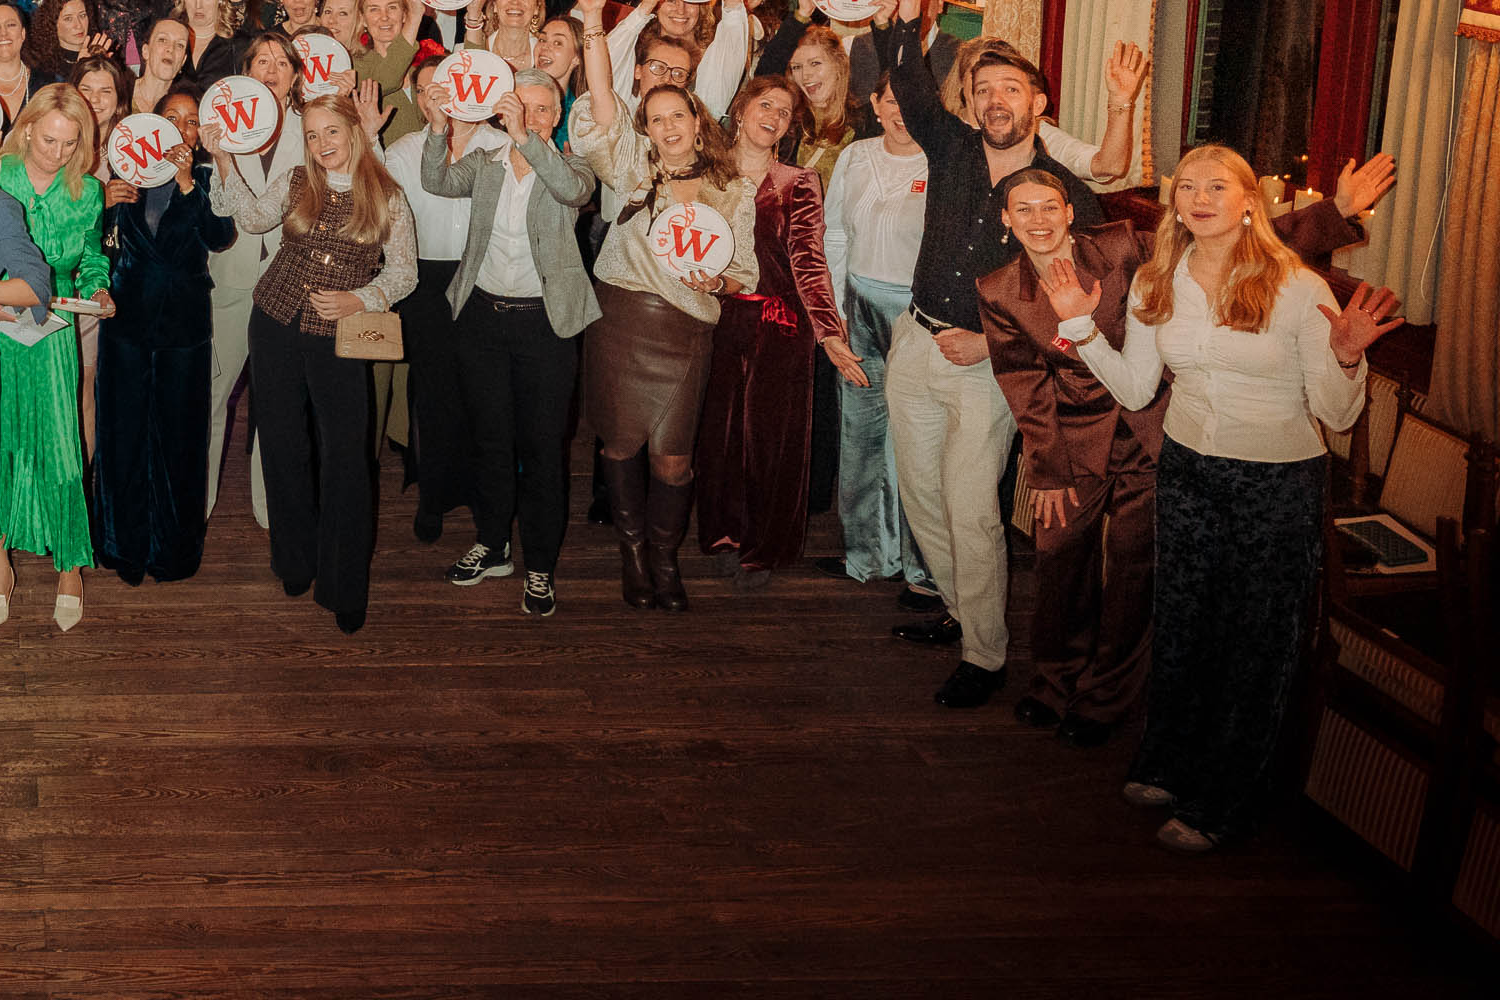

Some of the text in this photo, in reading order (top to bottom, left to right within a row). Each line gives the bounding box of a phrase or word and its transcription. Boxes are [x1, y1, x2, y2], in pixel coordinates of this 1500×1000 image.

[302, 54, 334, 84] W
[451, 72, 499, 104] W
[216, 97, 260, 133] W
[120, 129, 163, 169] W
[671, 223, 721, 262] W
